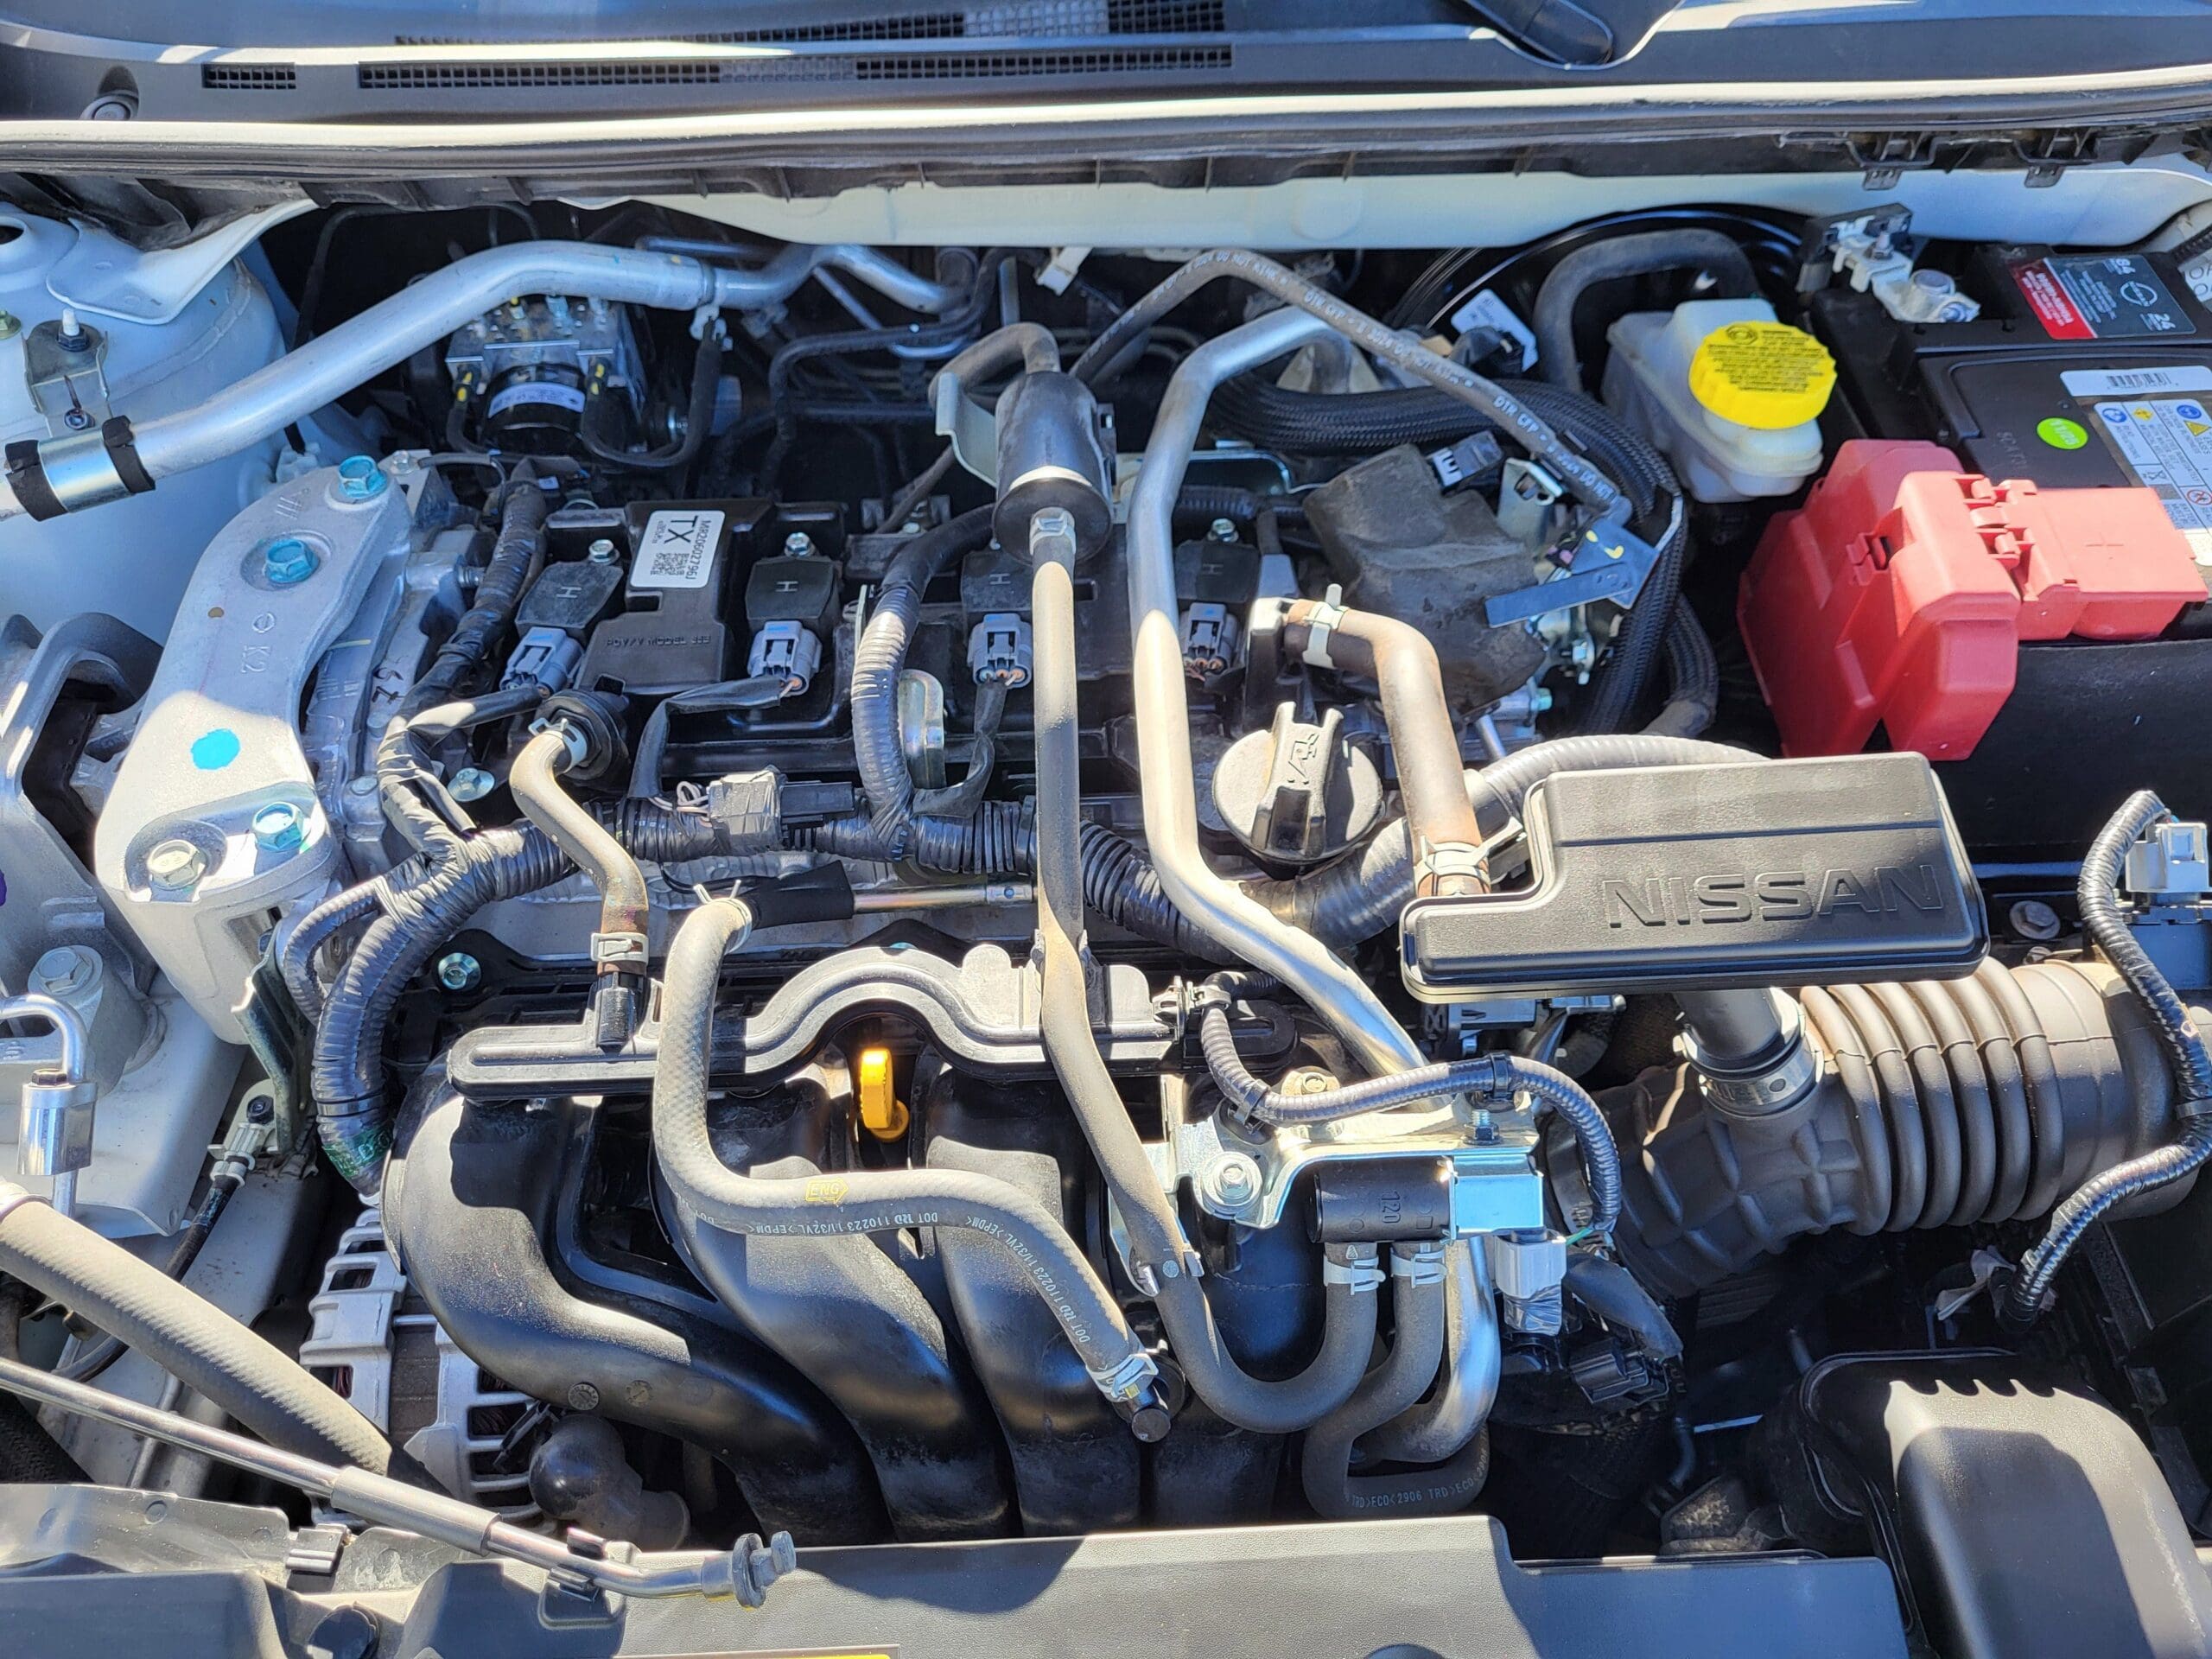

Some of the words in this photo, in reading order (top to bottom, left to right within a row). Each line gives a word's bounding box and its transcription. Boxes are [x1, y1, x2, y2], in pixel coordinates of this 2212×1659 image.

[664, 515, 699, 544] TX
[1602, 864, 1946, 929] NISSAN
[809, 1180, 841, 1197] ENG
[847, 1216, 891, 1233] 110223
[918, 1212, 938, 1224] DOT
[1033, 1266, 1065, 1304] 110223
[1070, 1324, 1091, 1344] DOT
